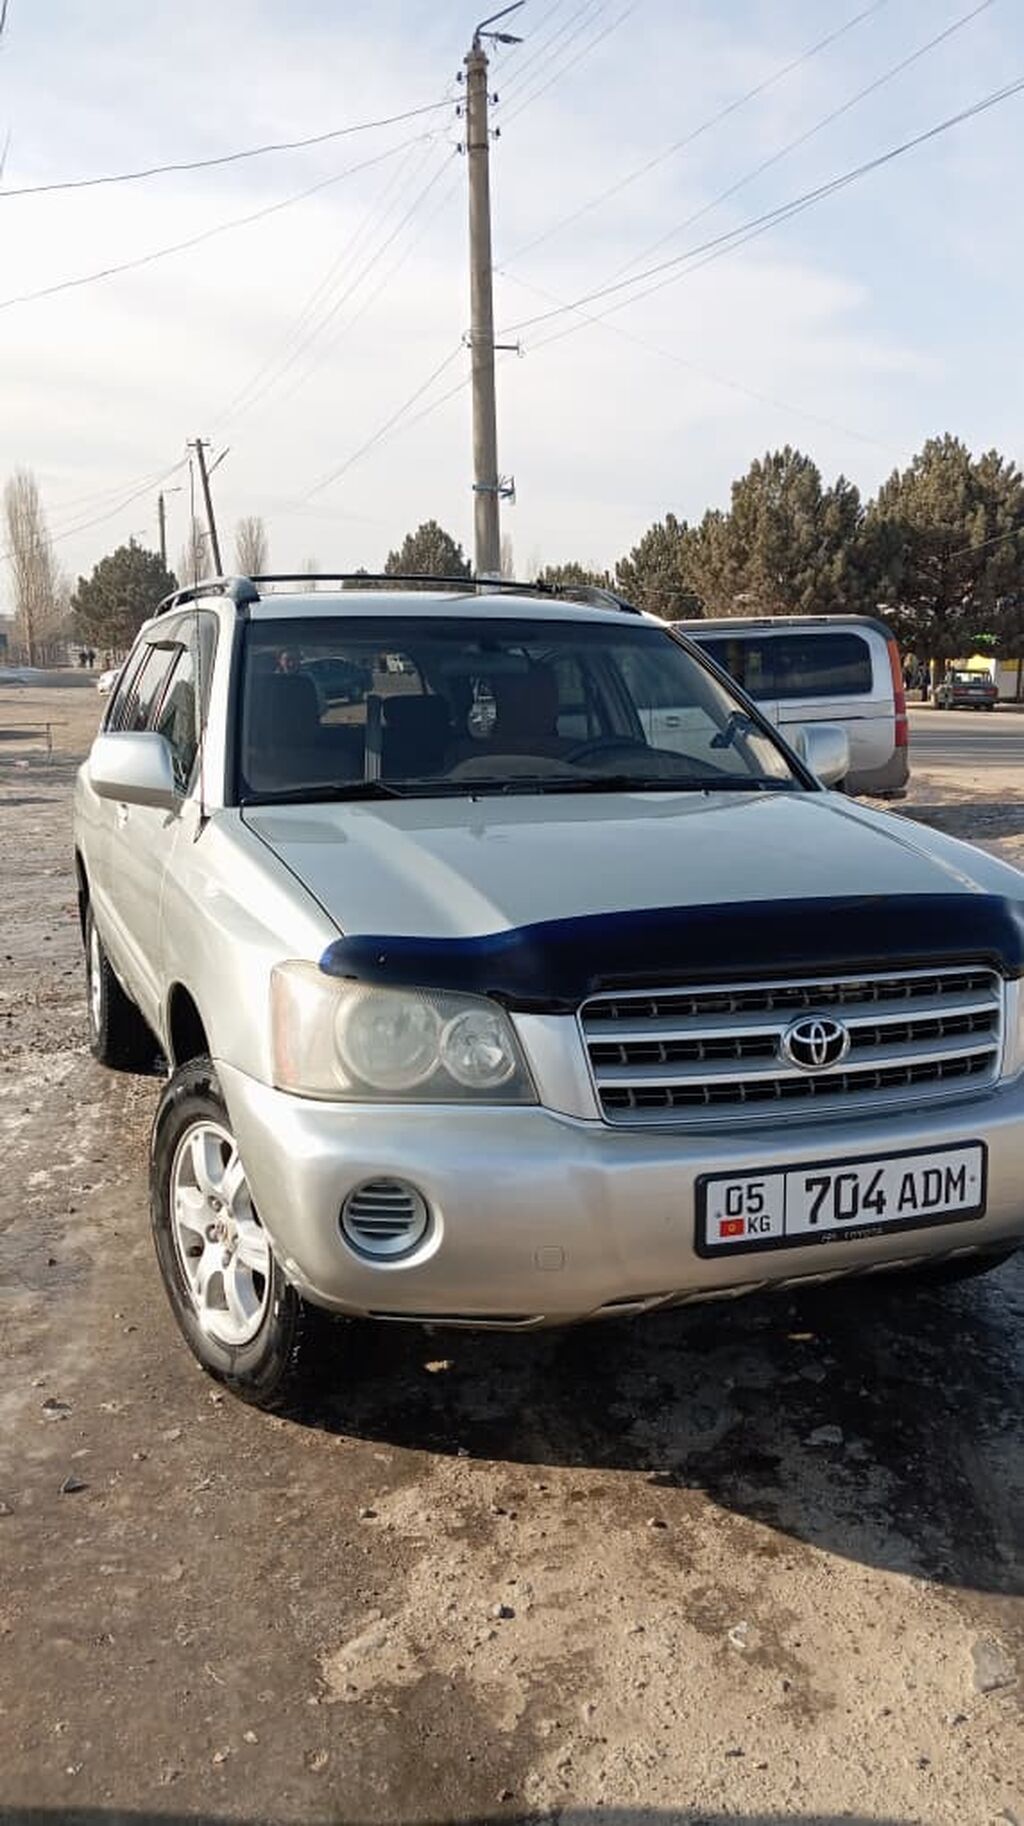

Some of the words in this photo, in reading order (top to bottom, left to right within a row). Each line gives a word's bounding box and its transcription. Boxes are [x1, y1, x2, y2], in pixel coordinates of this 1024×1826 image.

[725, 1182, 765, 1216] 05
[805, 1169, 887, 1225] 704
[898, 1164, 966, 1212] ADM
[747, 1215, 771, 1234] KG
